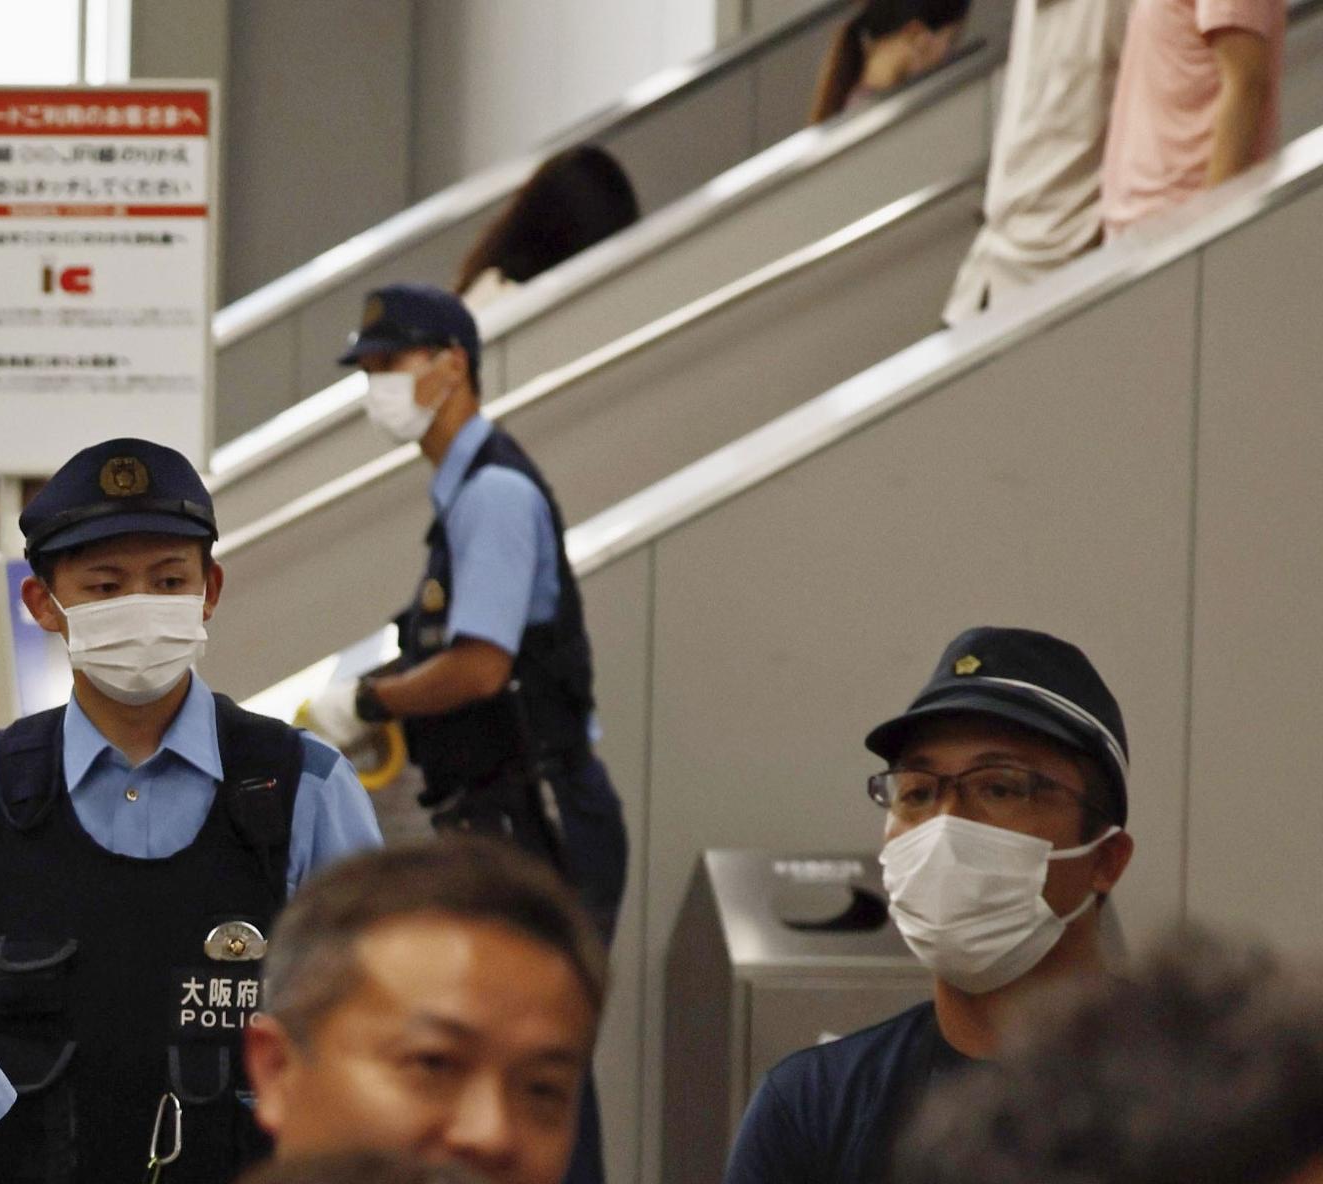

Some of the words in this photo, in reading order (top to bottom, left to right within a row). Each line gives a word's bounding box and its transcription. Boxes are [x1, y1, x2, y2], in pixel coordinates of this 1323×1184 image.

[180, 976, 260, 1009] 大阪府
[180, 1008, 264, 1029] POLIC
